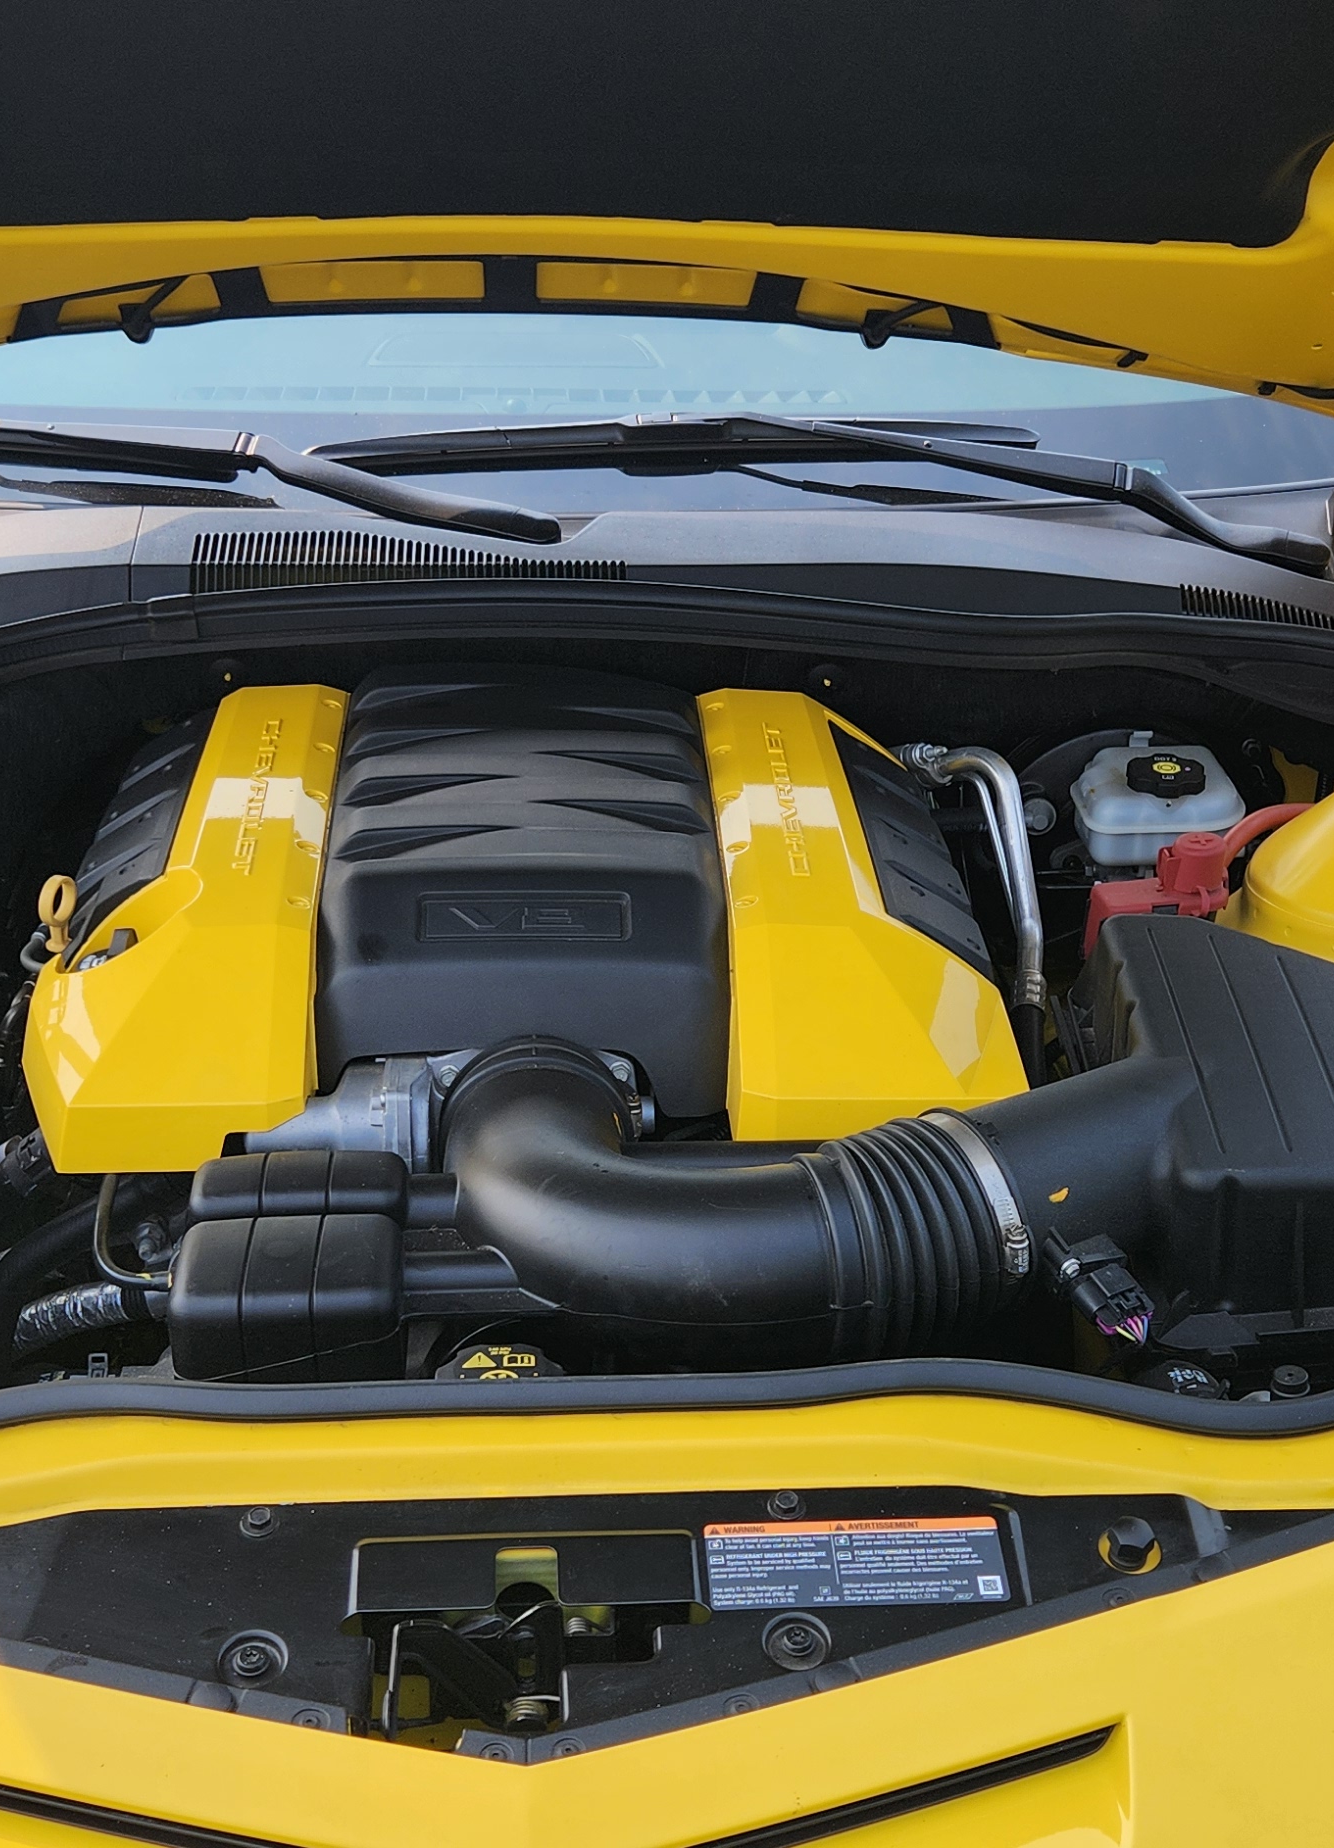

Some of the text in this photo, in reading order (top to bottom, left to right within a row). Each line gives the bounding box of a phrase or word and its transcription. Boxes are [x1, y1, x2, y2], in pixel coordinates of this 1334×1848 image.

[232, 718, 282, 876] CHEVROLET
[762, 722, 811, 877] CHEVROLET
[449, 906, 585, 930] V8
[724, 1526, 765, 1534] WARNING
[848, 1522, 919, 1530] AVERTISSEMENT
